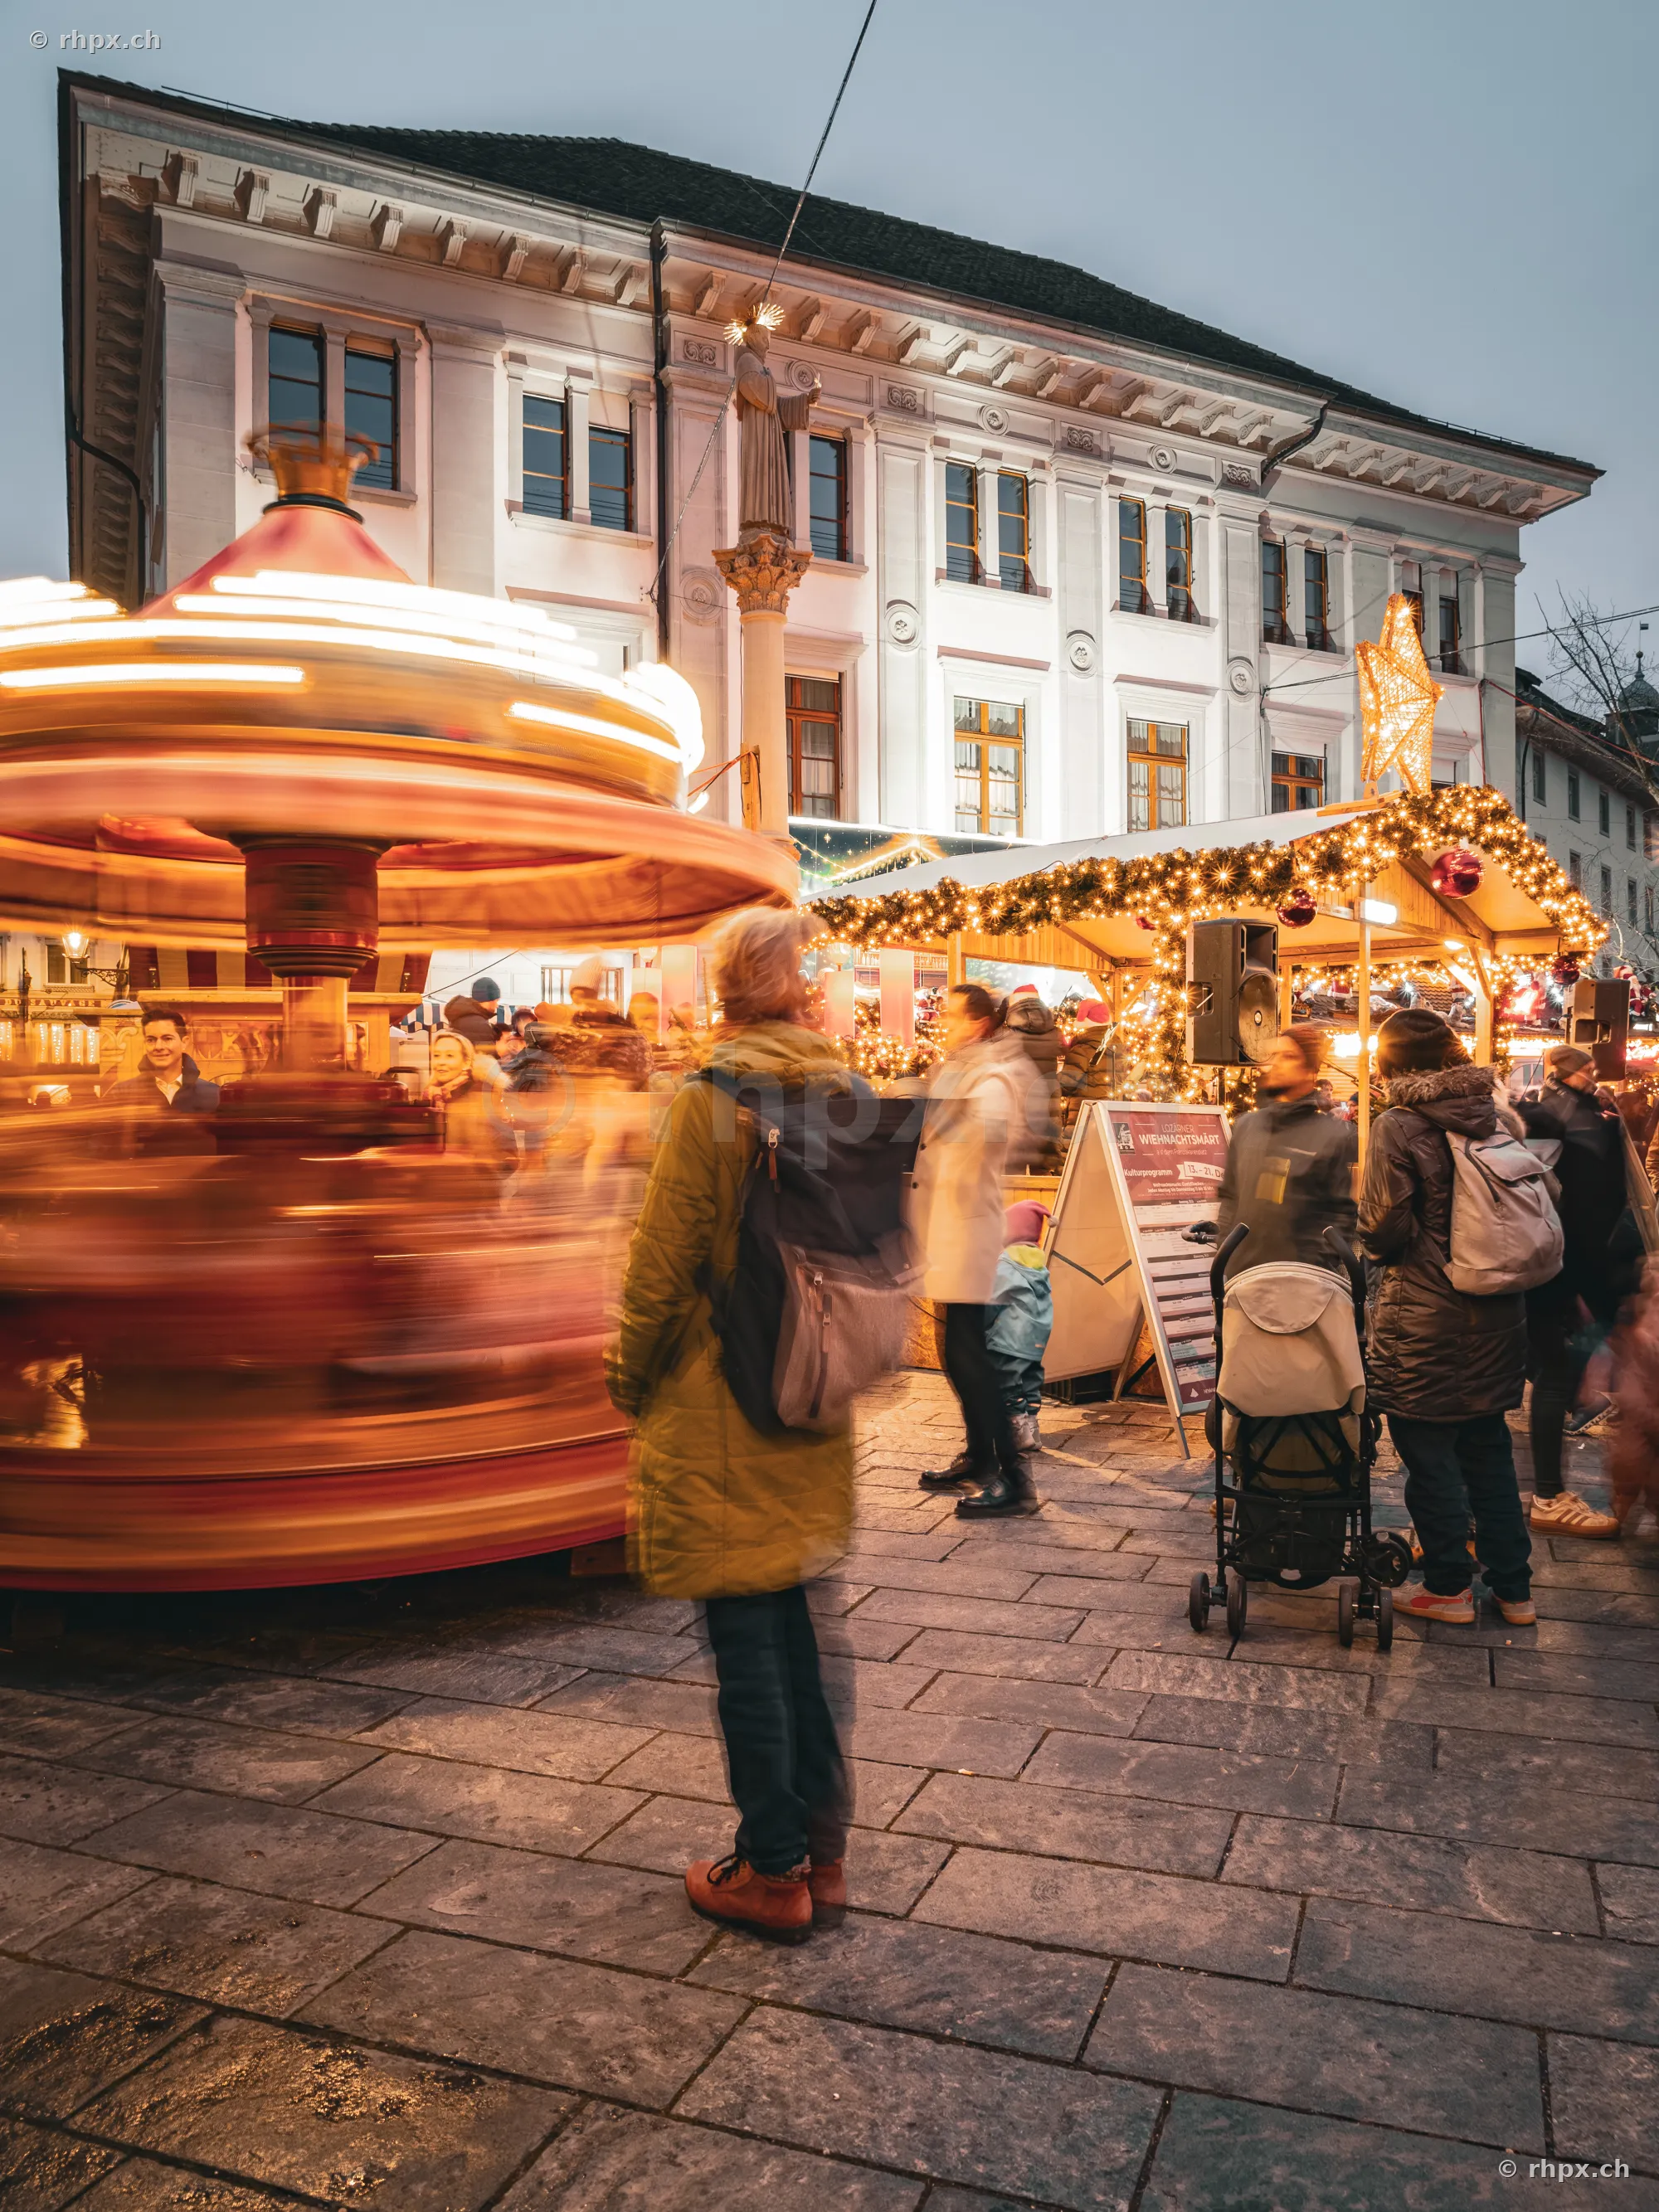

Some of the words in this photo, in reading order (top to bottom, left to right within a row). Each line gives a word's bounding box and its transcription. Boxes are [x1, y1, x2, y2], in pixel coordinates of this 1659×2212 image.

[30, 999, 95, 1007] SAUVAGE
[1139, 1133, 1219, 1145] WIEHNACHTSMÄRT
[1124, 1169, 1173, 1178] Kulturprogramm
[1188, 1164, 1198, 1174] 13.
[1204, 1166, 1214, 1176] 21.
[1215, 1169, 1224, 1179] De
